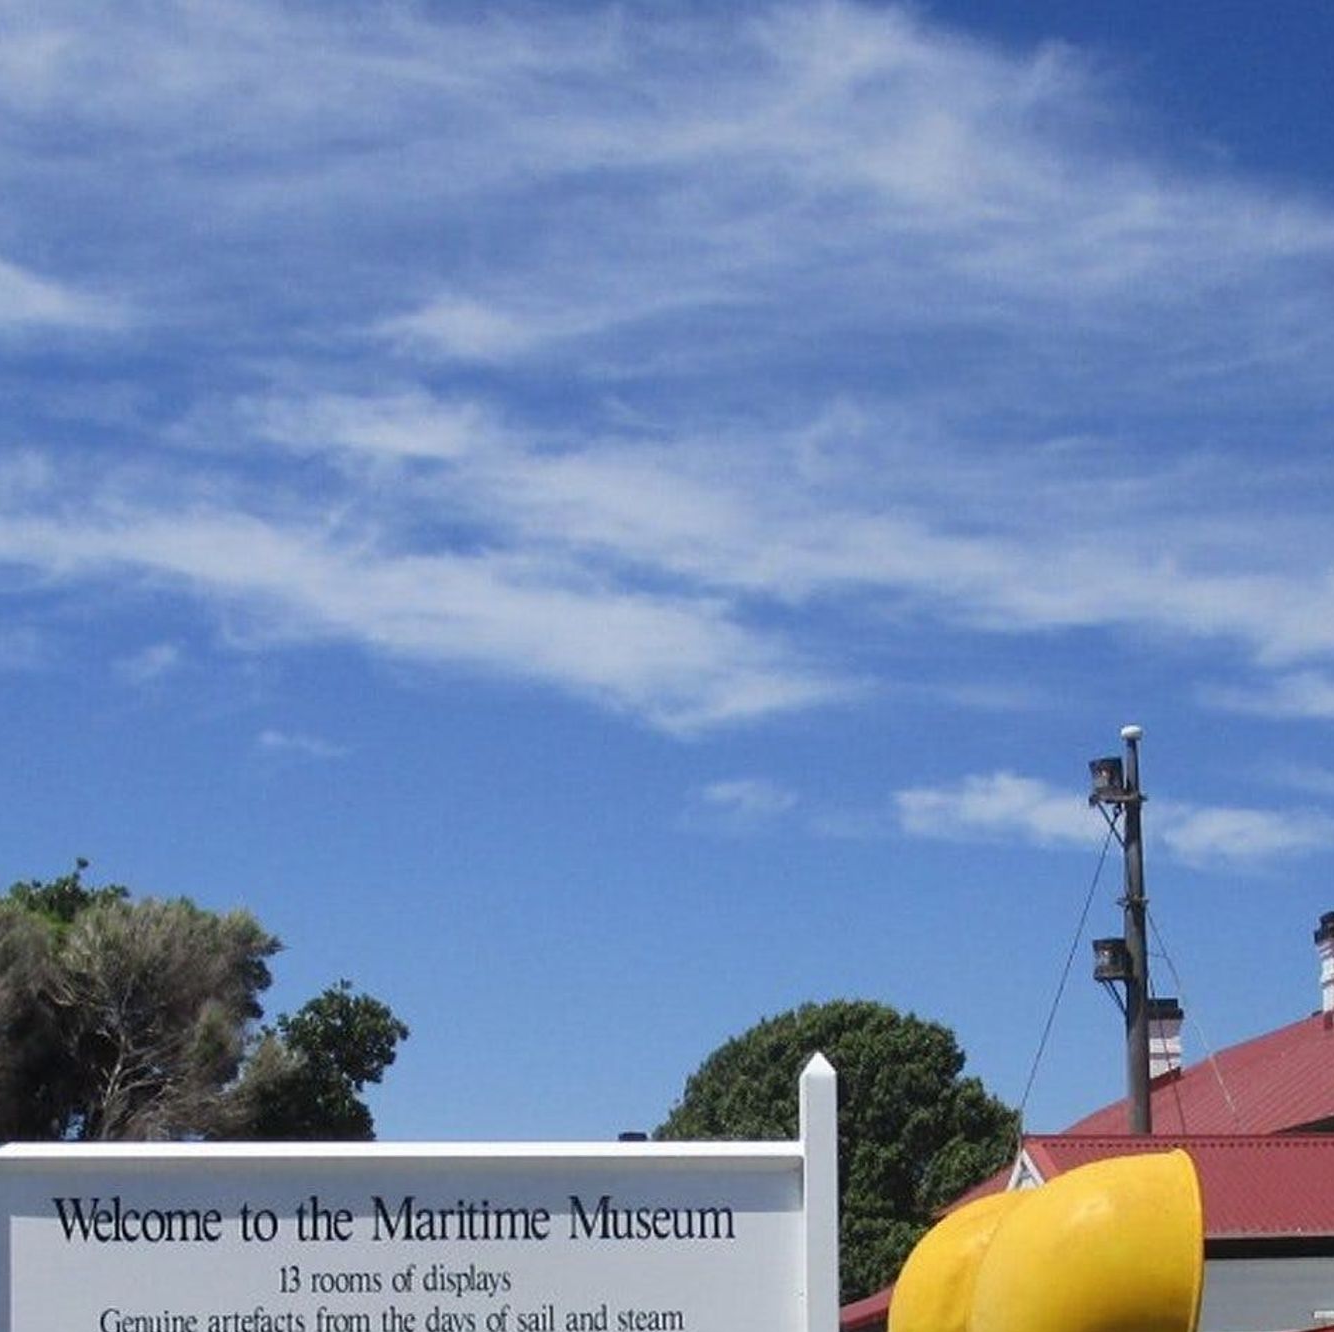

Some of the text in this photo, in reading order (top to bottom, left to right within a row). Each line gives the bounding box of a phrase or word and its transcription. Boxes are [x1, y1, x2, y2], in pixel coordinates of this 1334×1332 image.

[52, 1195, 737, 1243] Welcome to the Maritime Museum
[279, 1263, 512, 1298] 13 rooms of displays
[485, 1304, 511, 1332] of
[516, 1304, 556, 1332] sail
[565, 1303, 608, 1332] and
[617, 1309, 685, 1332] steam
